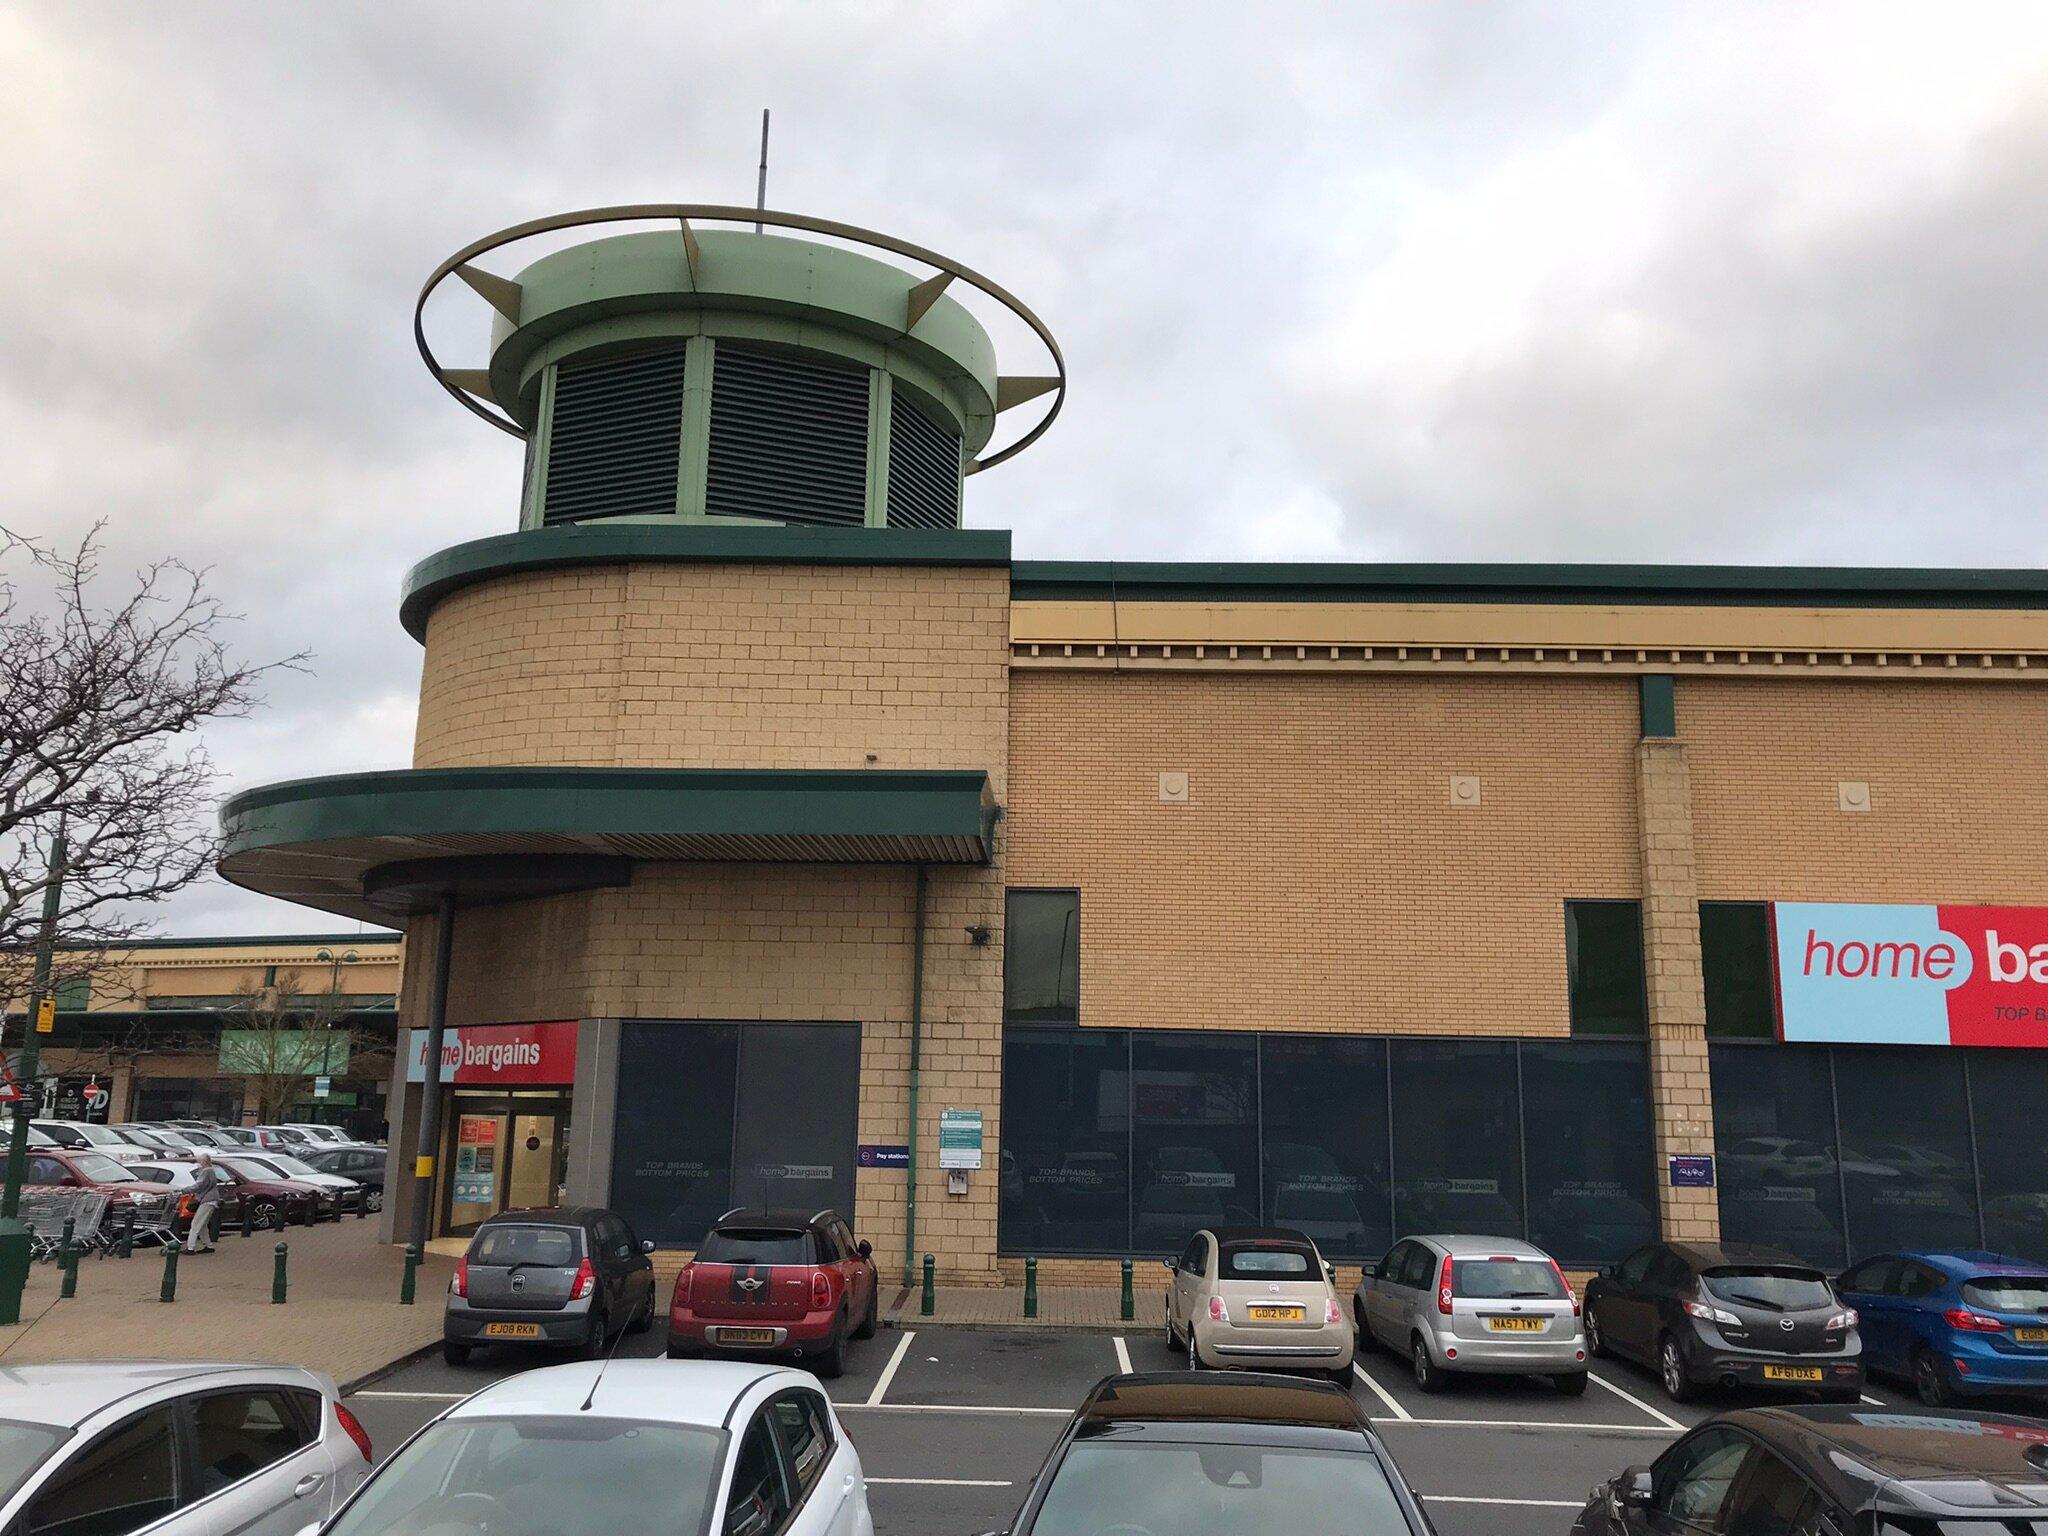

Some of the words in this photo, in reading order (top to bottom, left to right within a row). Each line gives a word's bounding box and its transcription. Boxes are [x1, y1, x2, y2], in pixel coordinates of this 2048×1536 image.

[1803, 929, 1956, 980] home
[1995, 1006, 2029, 1020] TOP
[419, 1041, 459, 1066] hme
[465, 1038, 540, 1071] bargains
[876, 1152, 887, 1160] Pay
[645, 1161, 664, 1169] TOP
[666, 1161, 704, 1170] BRANDS
[634, 1169, 672, 1177] BOTTOM
[675, 1169, 709, 1178] PRICES
[759, 1167, 786, 1177] home
[790, 1168, 829, 1179] bargains
[1038, 1168, 1058, 1176] TOP
[1059, 1168, 1096, 1177] BRANDS
[1029, 1175, 1066, 1183] BOTTOM
[1069, 1176, 1104, 1184] PRICES
[1161, 1174, 1188, 1185] home
[1192, 1176, 1232, 1186] bargains
[1320, 1175, 1358, 1184] BRANDS
[1279, 1309, 1298, 1319] HPJ
[1493, 1319, 1518, 1329] NA57
[1520, 1319, 1538, 1329] TWY
[490, 1324, 514, 1334] EJ08
[516, 1324, 535, 1335] RKN
[1771, 1367, 1794, 1378] AF61
